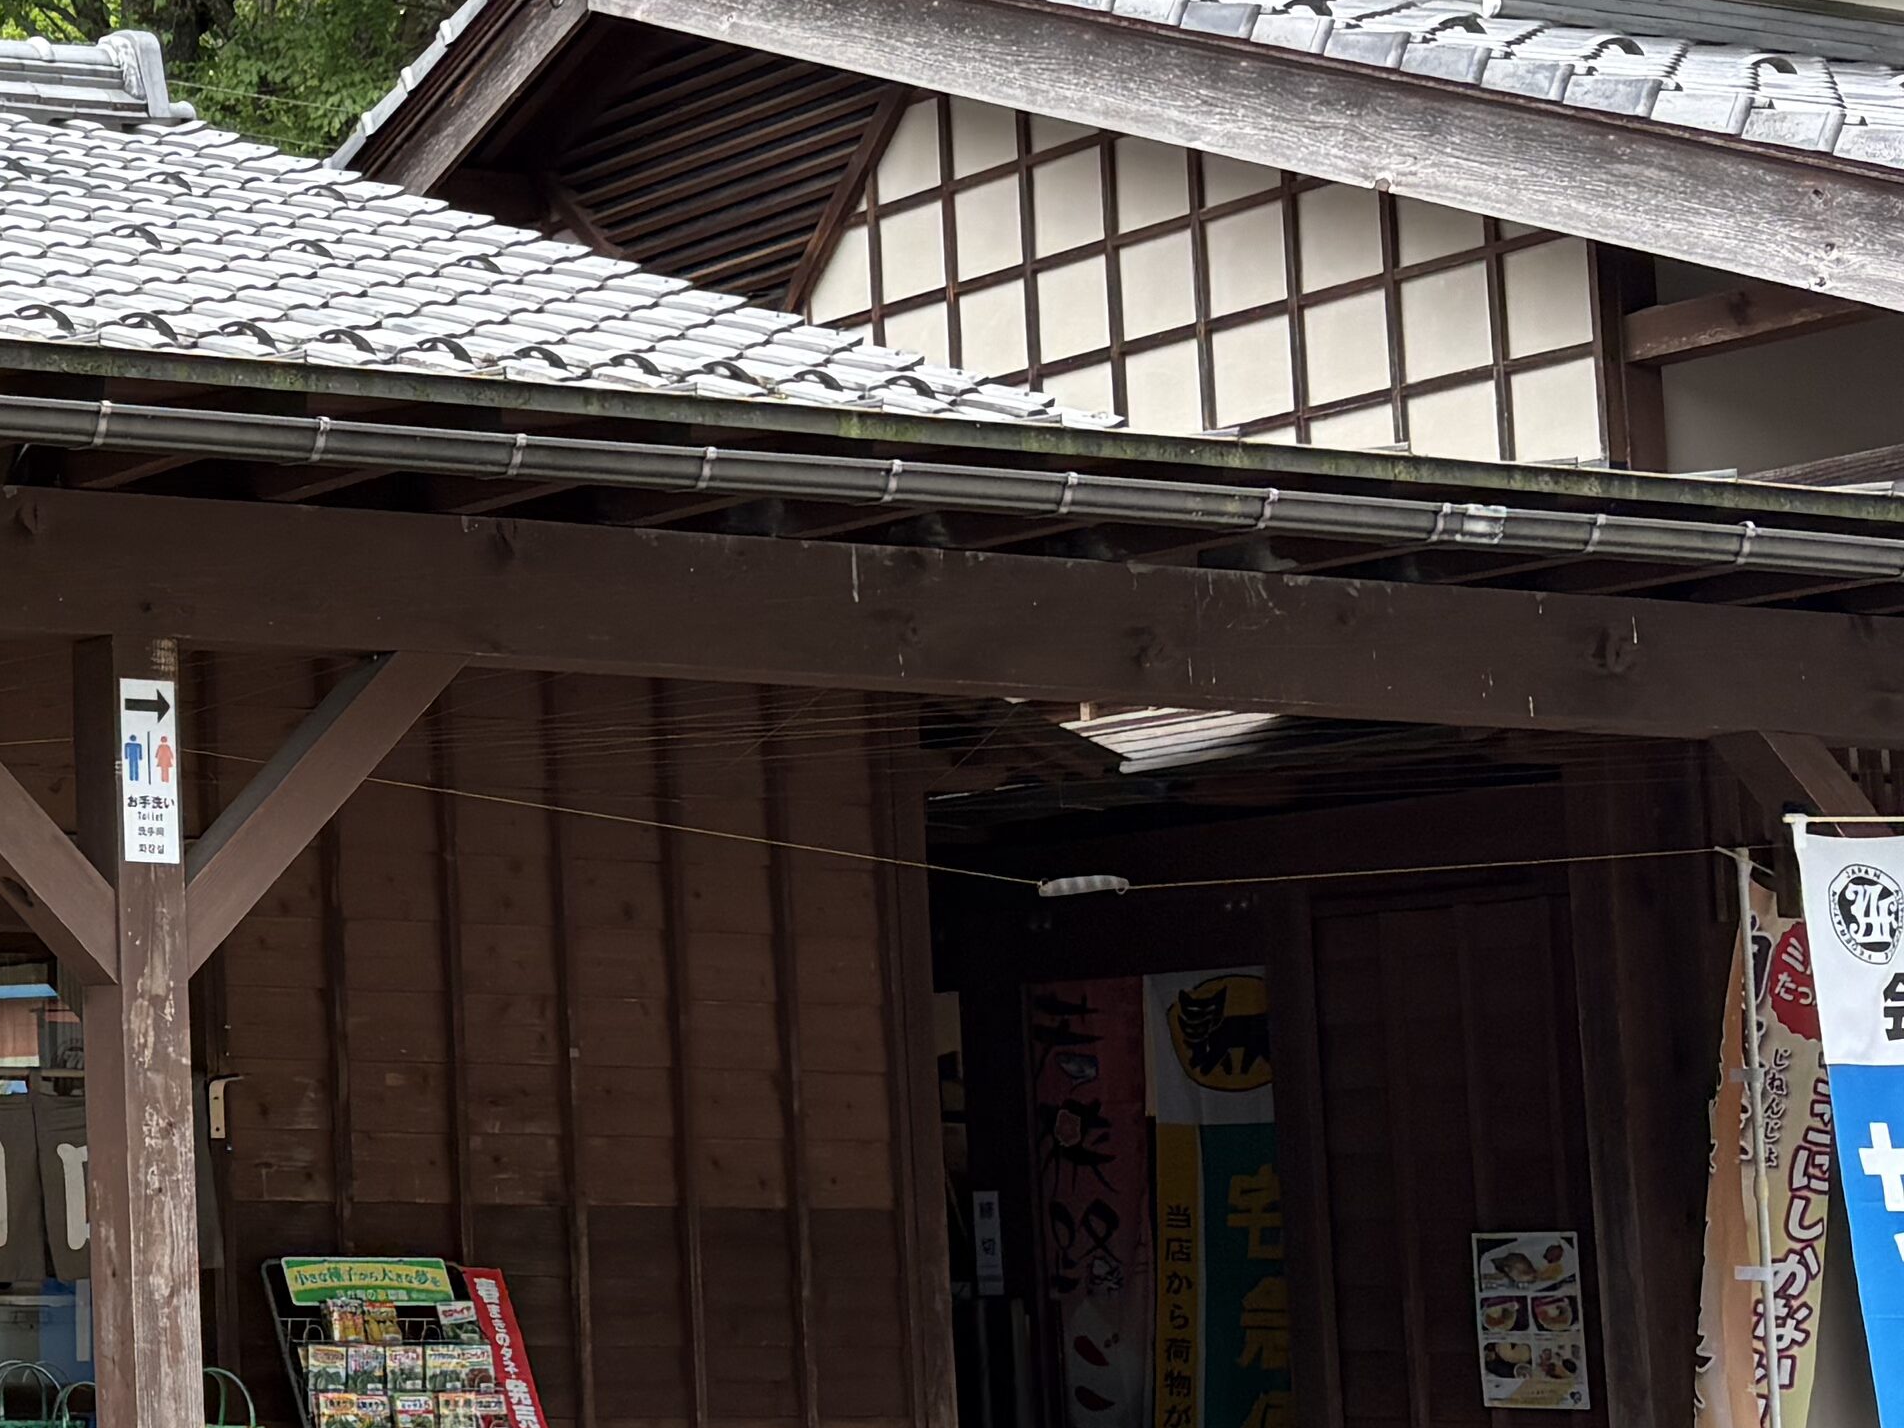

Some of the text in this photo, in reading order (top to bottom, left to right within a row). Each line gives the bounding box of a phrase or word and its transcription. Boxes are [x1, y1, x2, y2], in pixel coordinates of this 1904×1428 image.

[128, 795, 174, 809] お手洗い
[138, 811, 163, 822] Toilet
